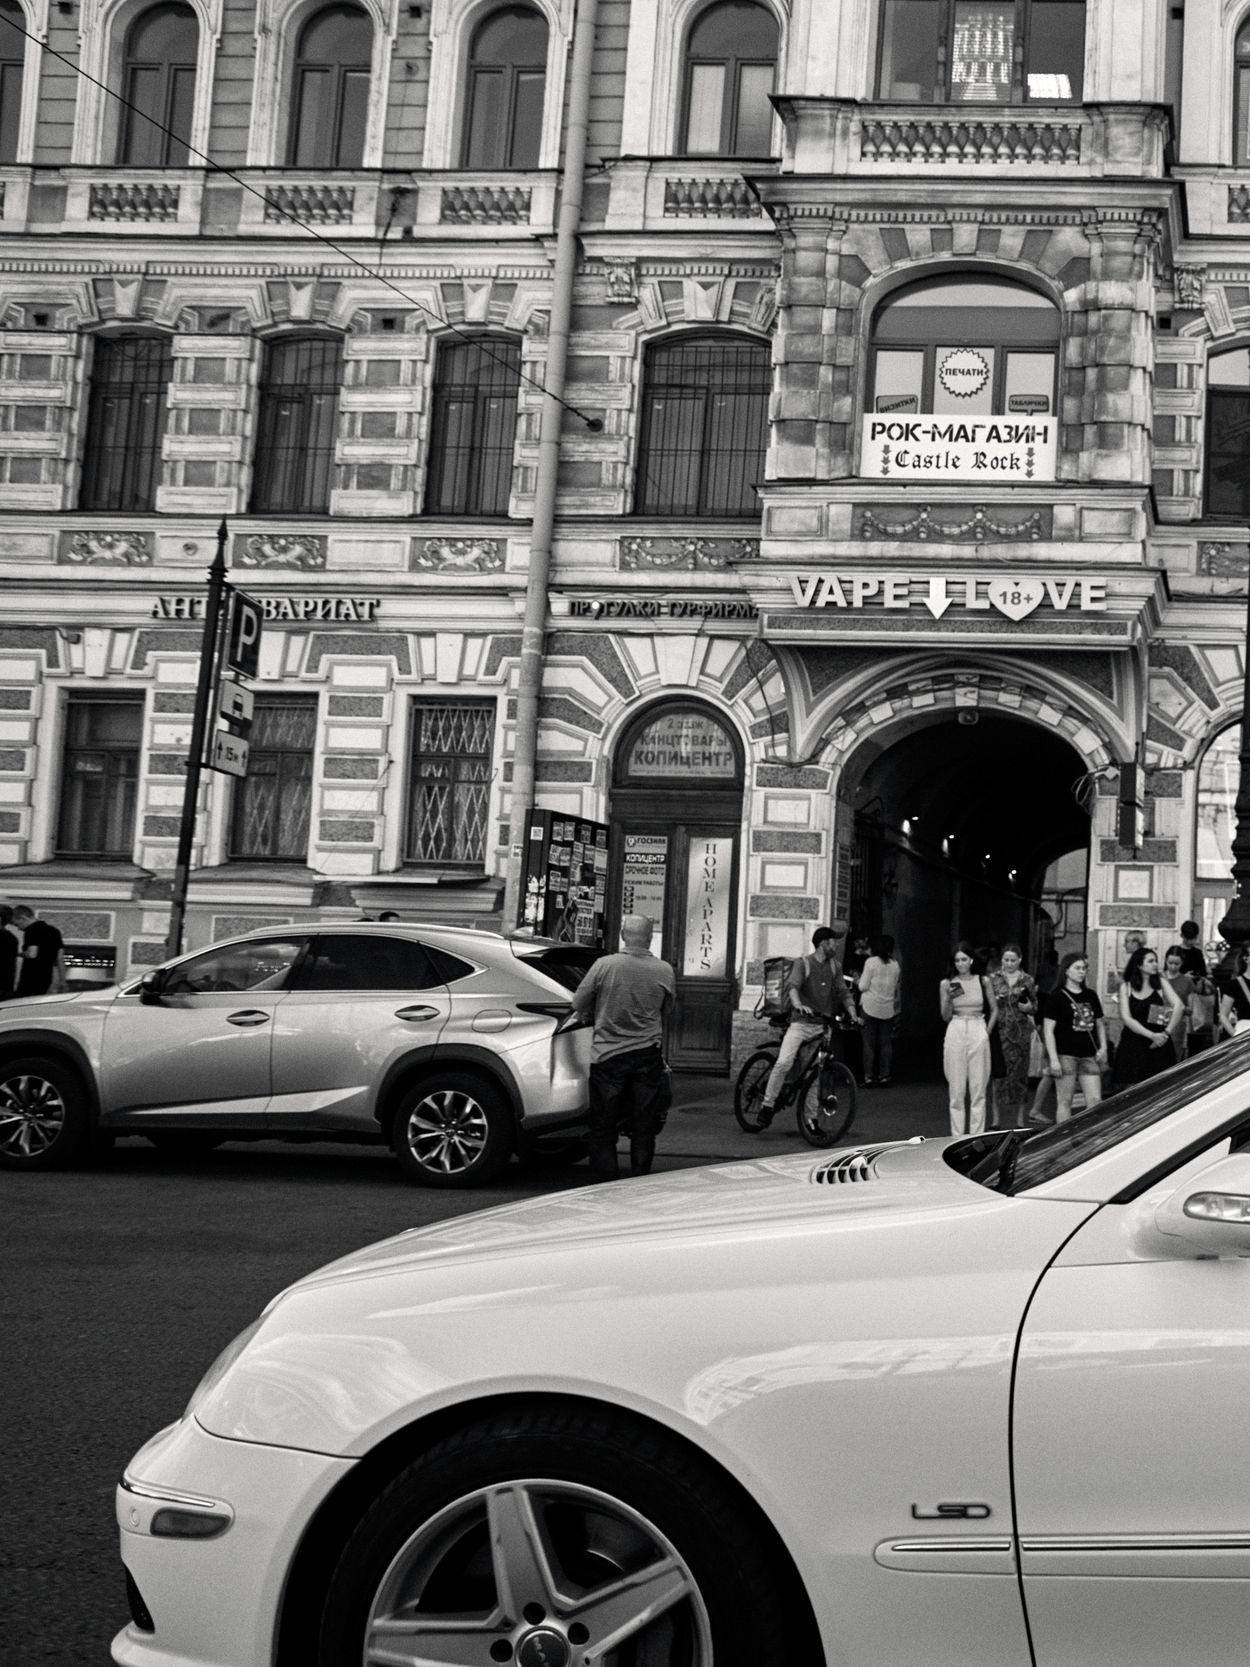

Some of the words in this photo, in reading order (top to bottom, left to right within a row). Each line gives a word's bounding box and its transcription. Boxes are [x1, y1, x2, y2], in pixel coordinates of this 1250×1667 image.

[944, 367, 984, 377] ПЕЧАТИ
[879, 396, 917, 414] ВИЗИТКИ
[870, 422, 1049, 444] РОК-МАГАЗИН
[894, 449, 961, 470] Castle
[970, 450, 1022, 471] Rock
[787, 575, 911, 609] VAPE
[997, 590, 1034, 606] 18+
[151, 597, 380, 621] АНТВАРИАТ
[667, 718, 674, 729] 2
[640, 734, 728, 748] КАНЦТОВАРЫ
[634, 750, 732, 768] КОПИЦЕНТР
[626, 854, 665, 863] КОПИЦЕНТР
[703, 842, 718, 893] HOME
[700, 896, 714, 970] APARTS
